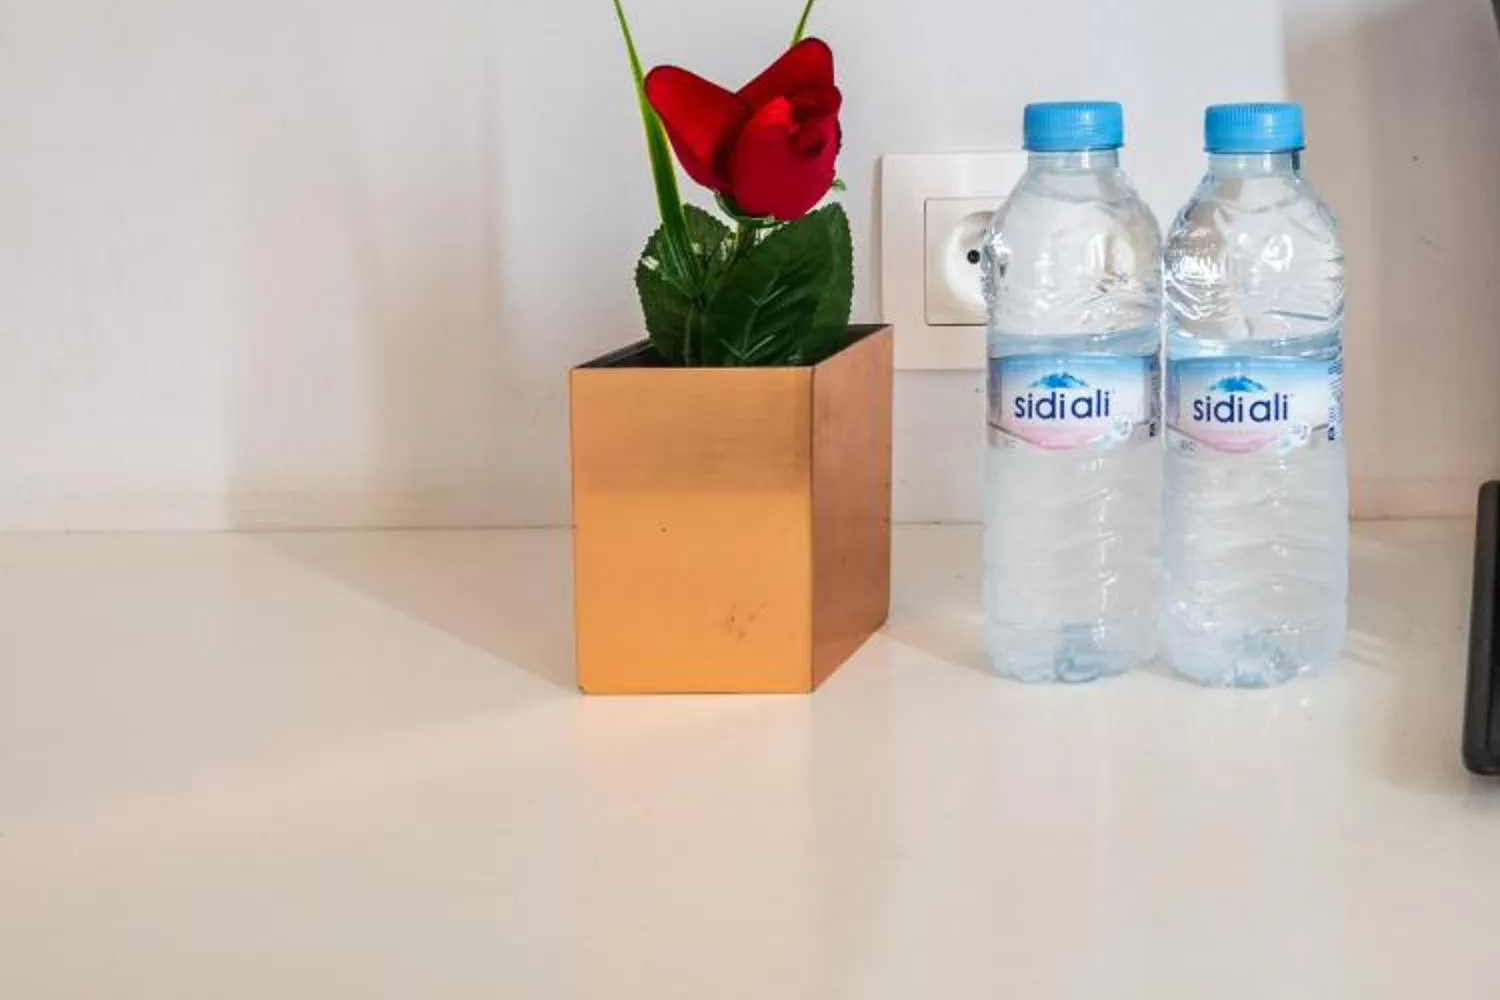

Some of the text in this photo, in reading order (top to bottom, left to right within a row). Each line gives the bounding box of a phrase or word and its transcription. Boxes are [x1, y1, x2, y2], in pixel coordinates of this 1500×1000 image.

[1013, 389, 1111, 420] sidi ali
[1192, 392, 1289, 423] sidi ali
